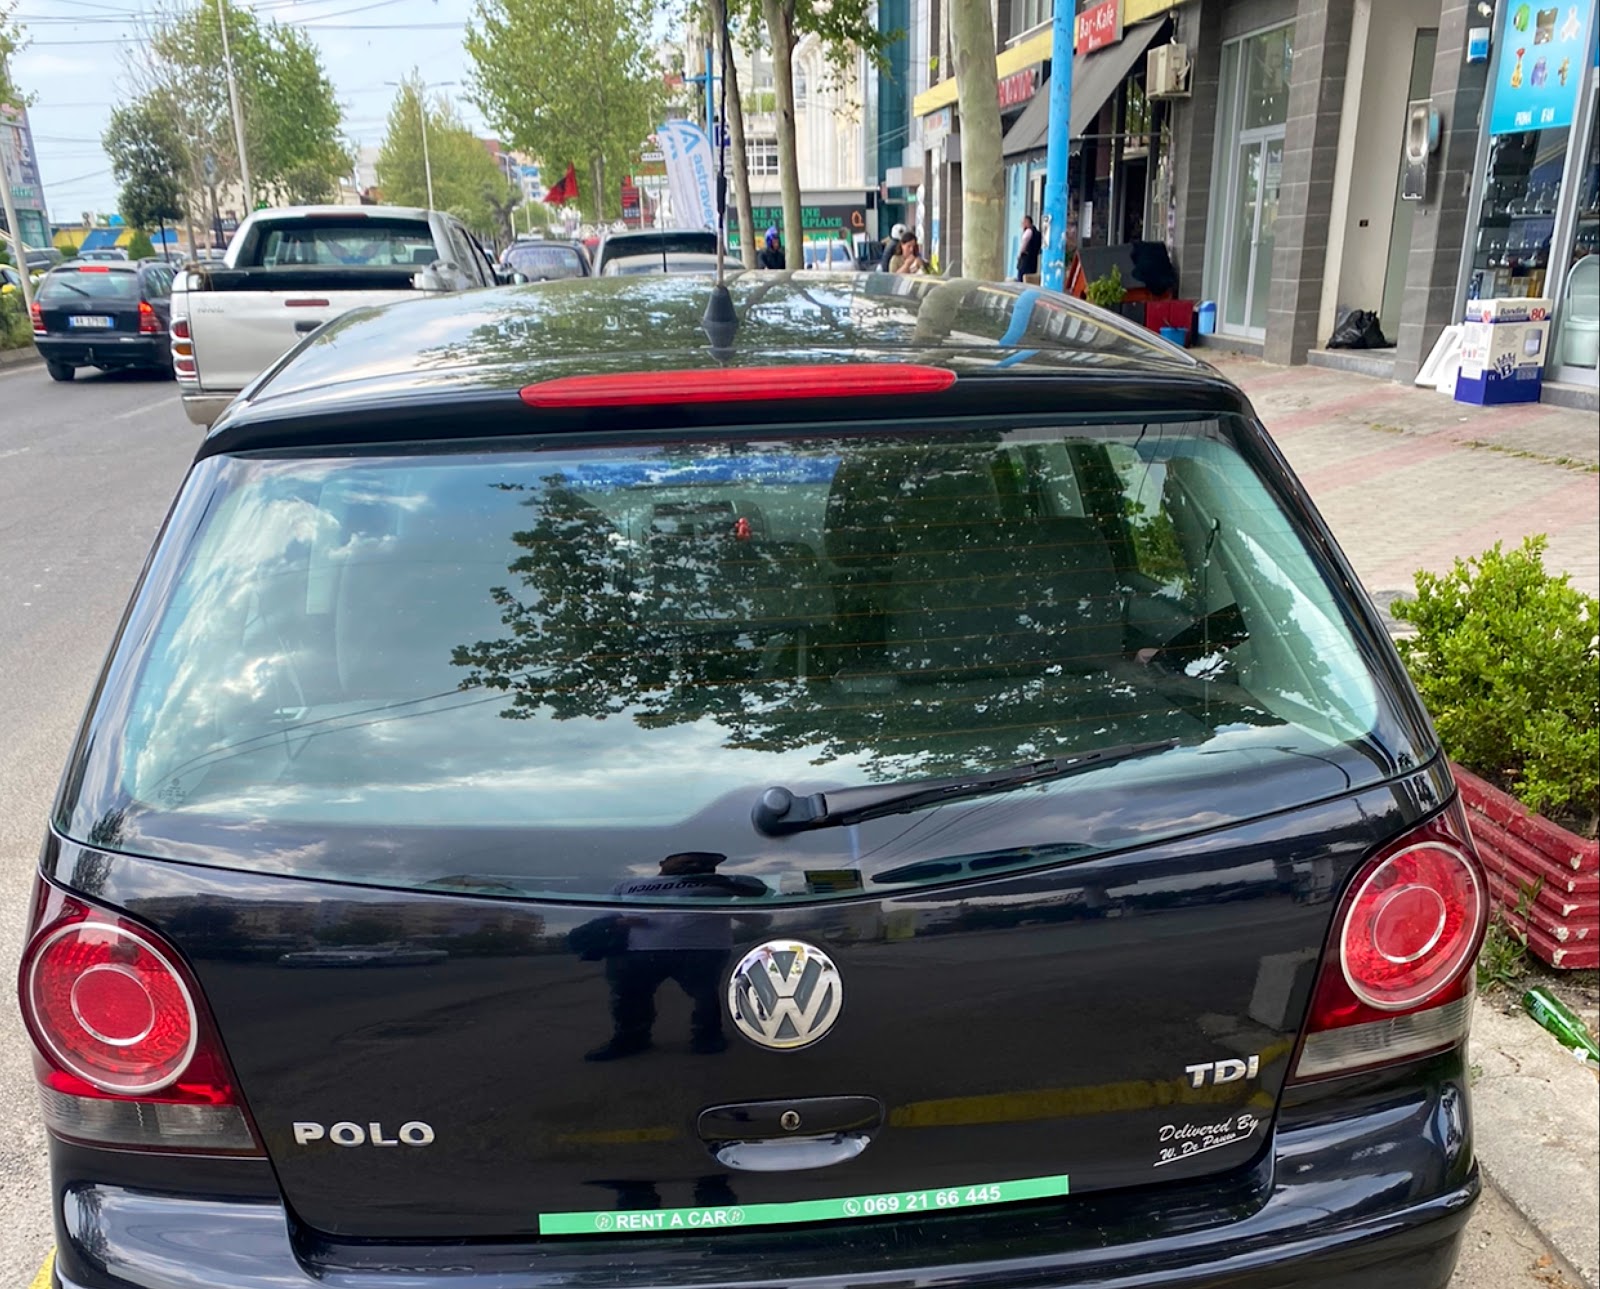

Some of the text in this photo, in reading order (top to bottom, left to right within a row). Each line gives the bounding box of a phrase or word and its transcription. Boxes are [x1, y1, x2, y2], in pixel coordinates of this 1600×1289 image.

[1080, 4, 1114, 39] Bar-Kafe
[1531, 307, 1545, 319] 80
[1185, 1055, 1259, 1088] TDI
[293, 1121, 435, 1147] POLO
[1159, 1114, 1259, 1142] Delivered By
[1160, 1147, 1177, 1160] W.
[1181, 1141, 1199, 1154] De
[864, 1186, 1001, 1214] 069 21 66 445
[616, 1210, 727, 1229] RENT A CAR
